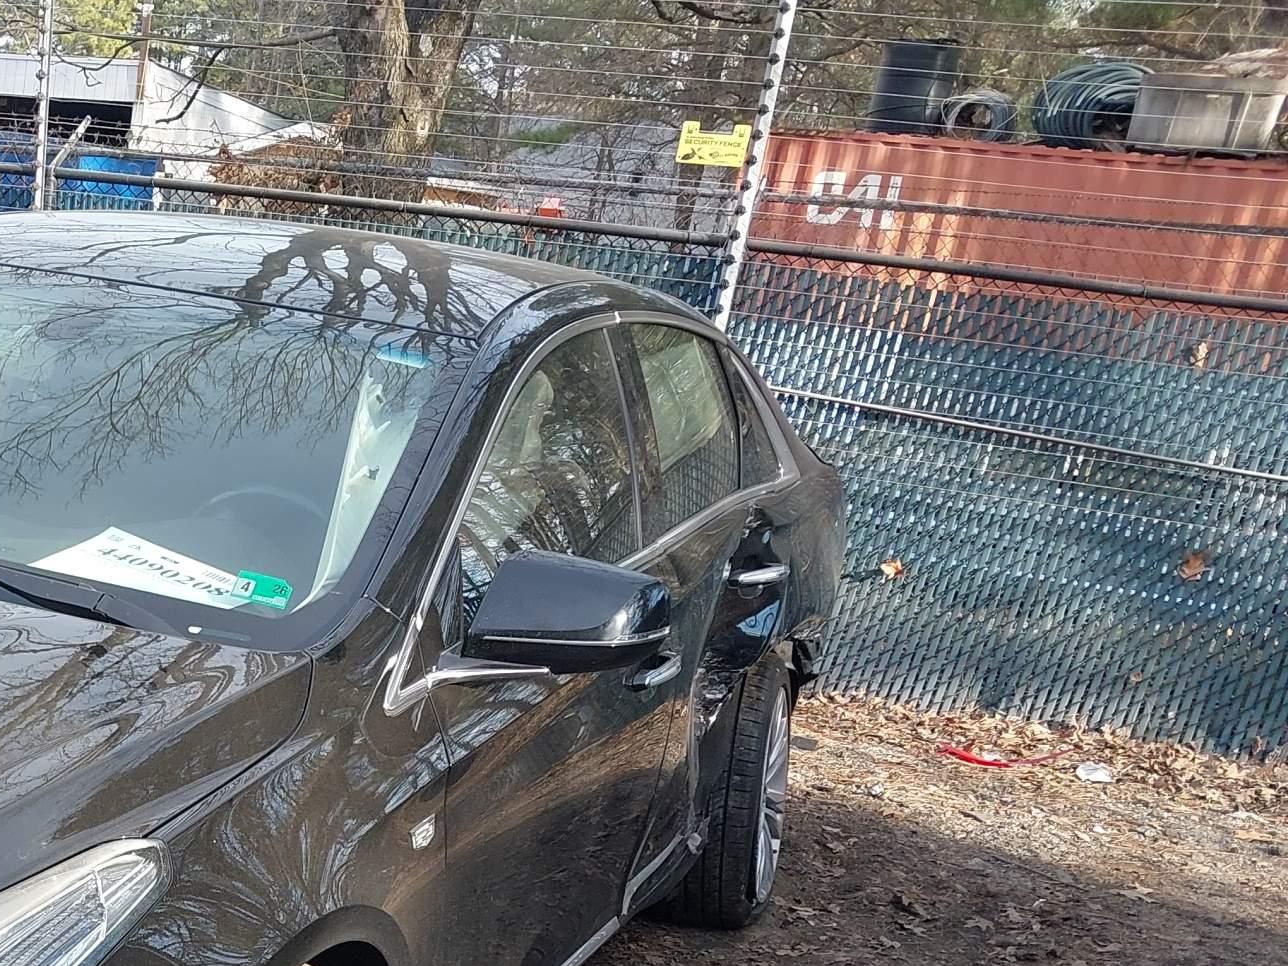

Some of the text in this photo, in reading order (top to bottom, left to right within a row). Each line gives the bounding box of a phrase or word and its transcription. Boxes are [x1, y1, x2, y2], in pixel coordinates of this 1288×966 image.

[719, 140, 742, 148] FENCE
[96, 547, 230, 596] 44090208
[240, 581, 251, 592] 4
[272, 583, 289, 596] 26
